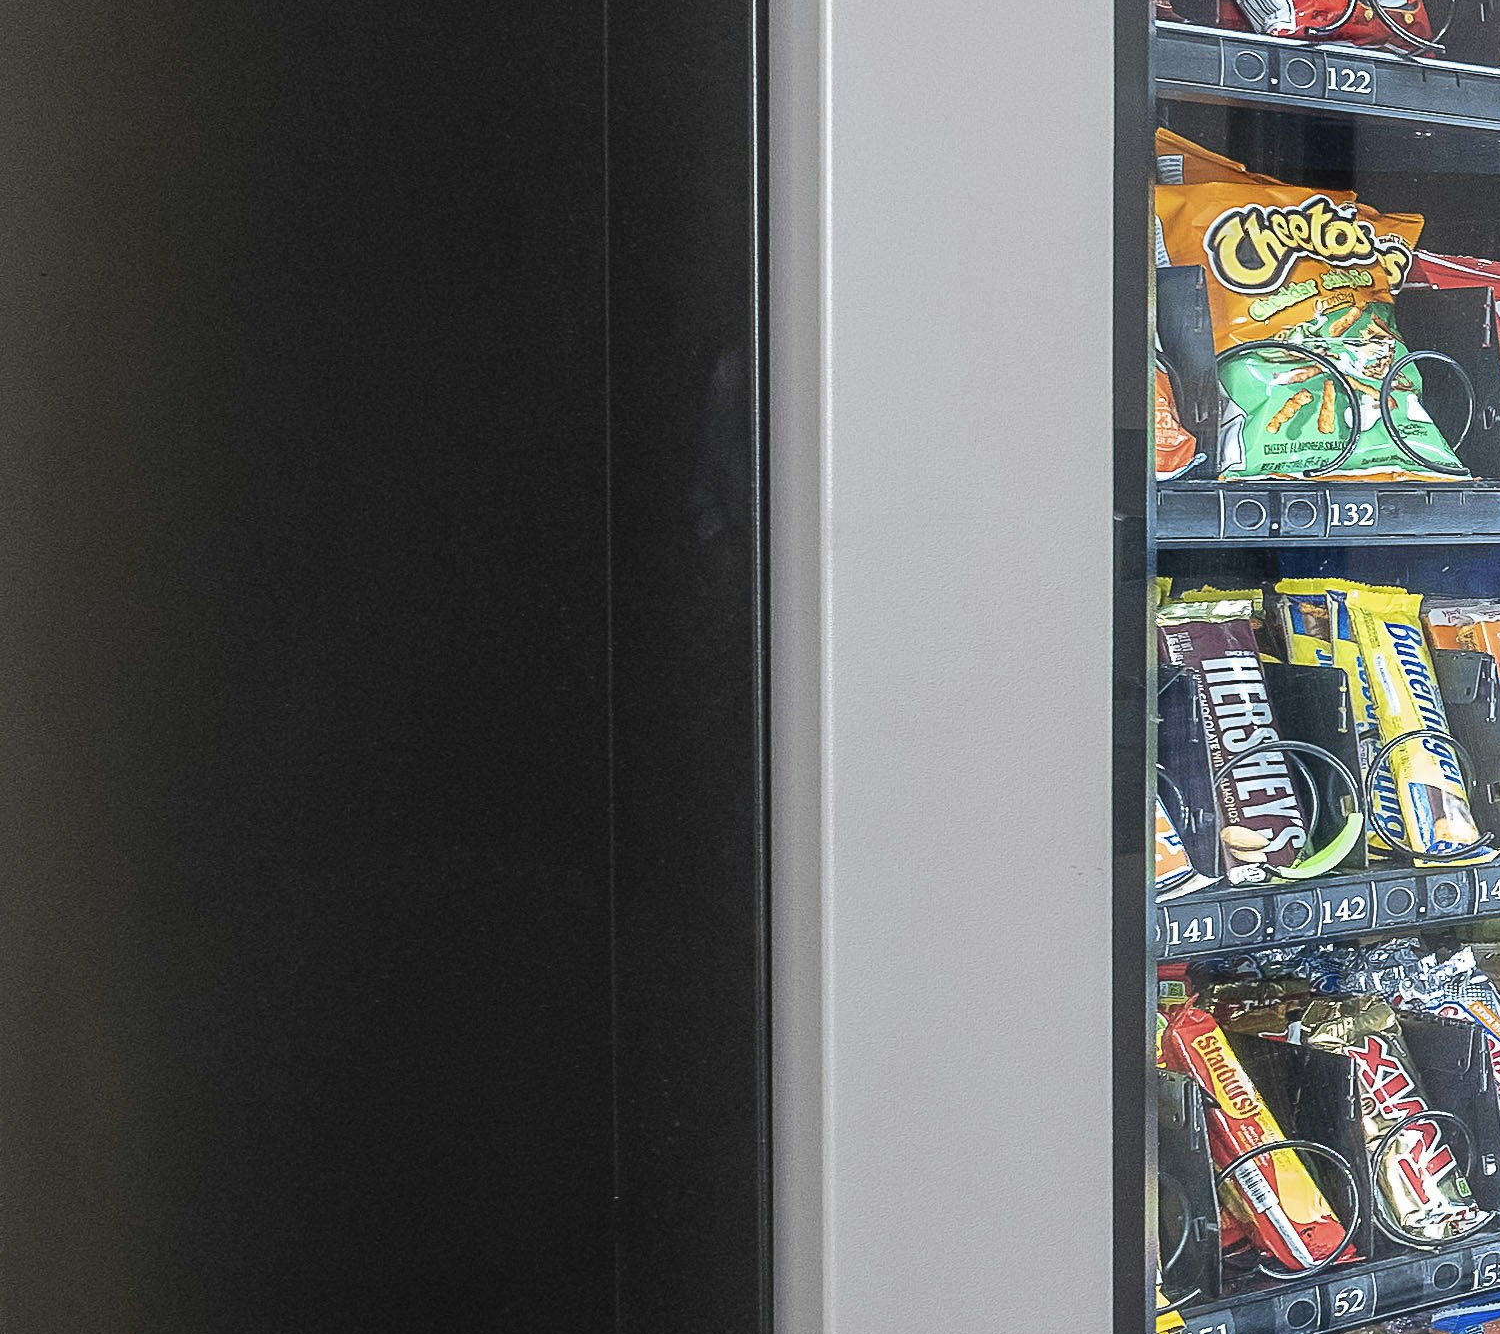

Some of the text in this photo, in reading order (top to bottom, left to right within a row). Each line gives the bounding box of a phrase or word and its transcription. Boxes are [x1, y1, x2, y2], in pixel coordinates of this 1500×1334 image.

[1326, 65, 1374, 95] 122
[1213, 201, 1375, 288] Cheetos
[1249, 279, 1320, 321] Cheddar
[1329, 503, 1376, 527] 132
[1384, 621, 1464, 791] Butterfinger
[1200, 656, 1308, 855] HERSHEY'S
[1168, 915, 1216, 945] 141
[1322, 895, 1368, 926] 142
[1196, 1033, 1260, 1119] Starburst
